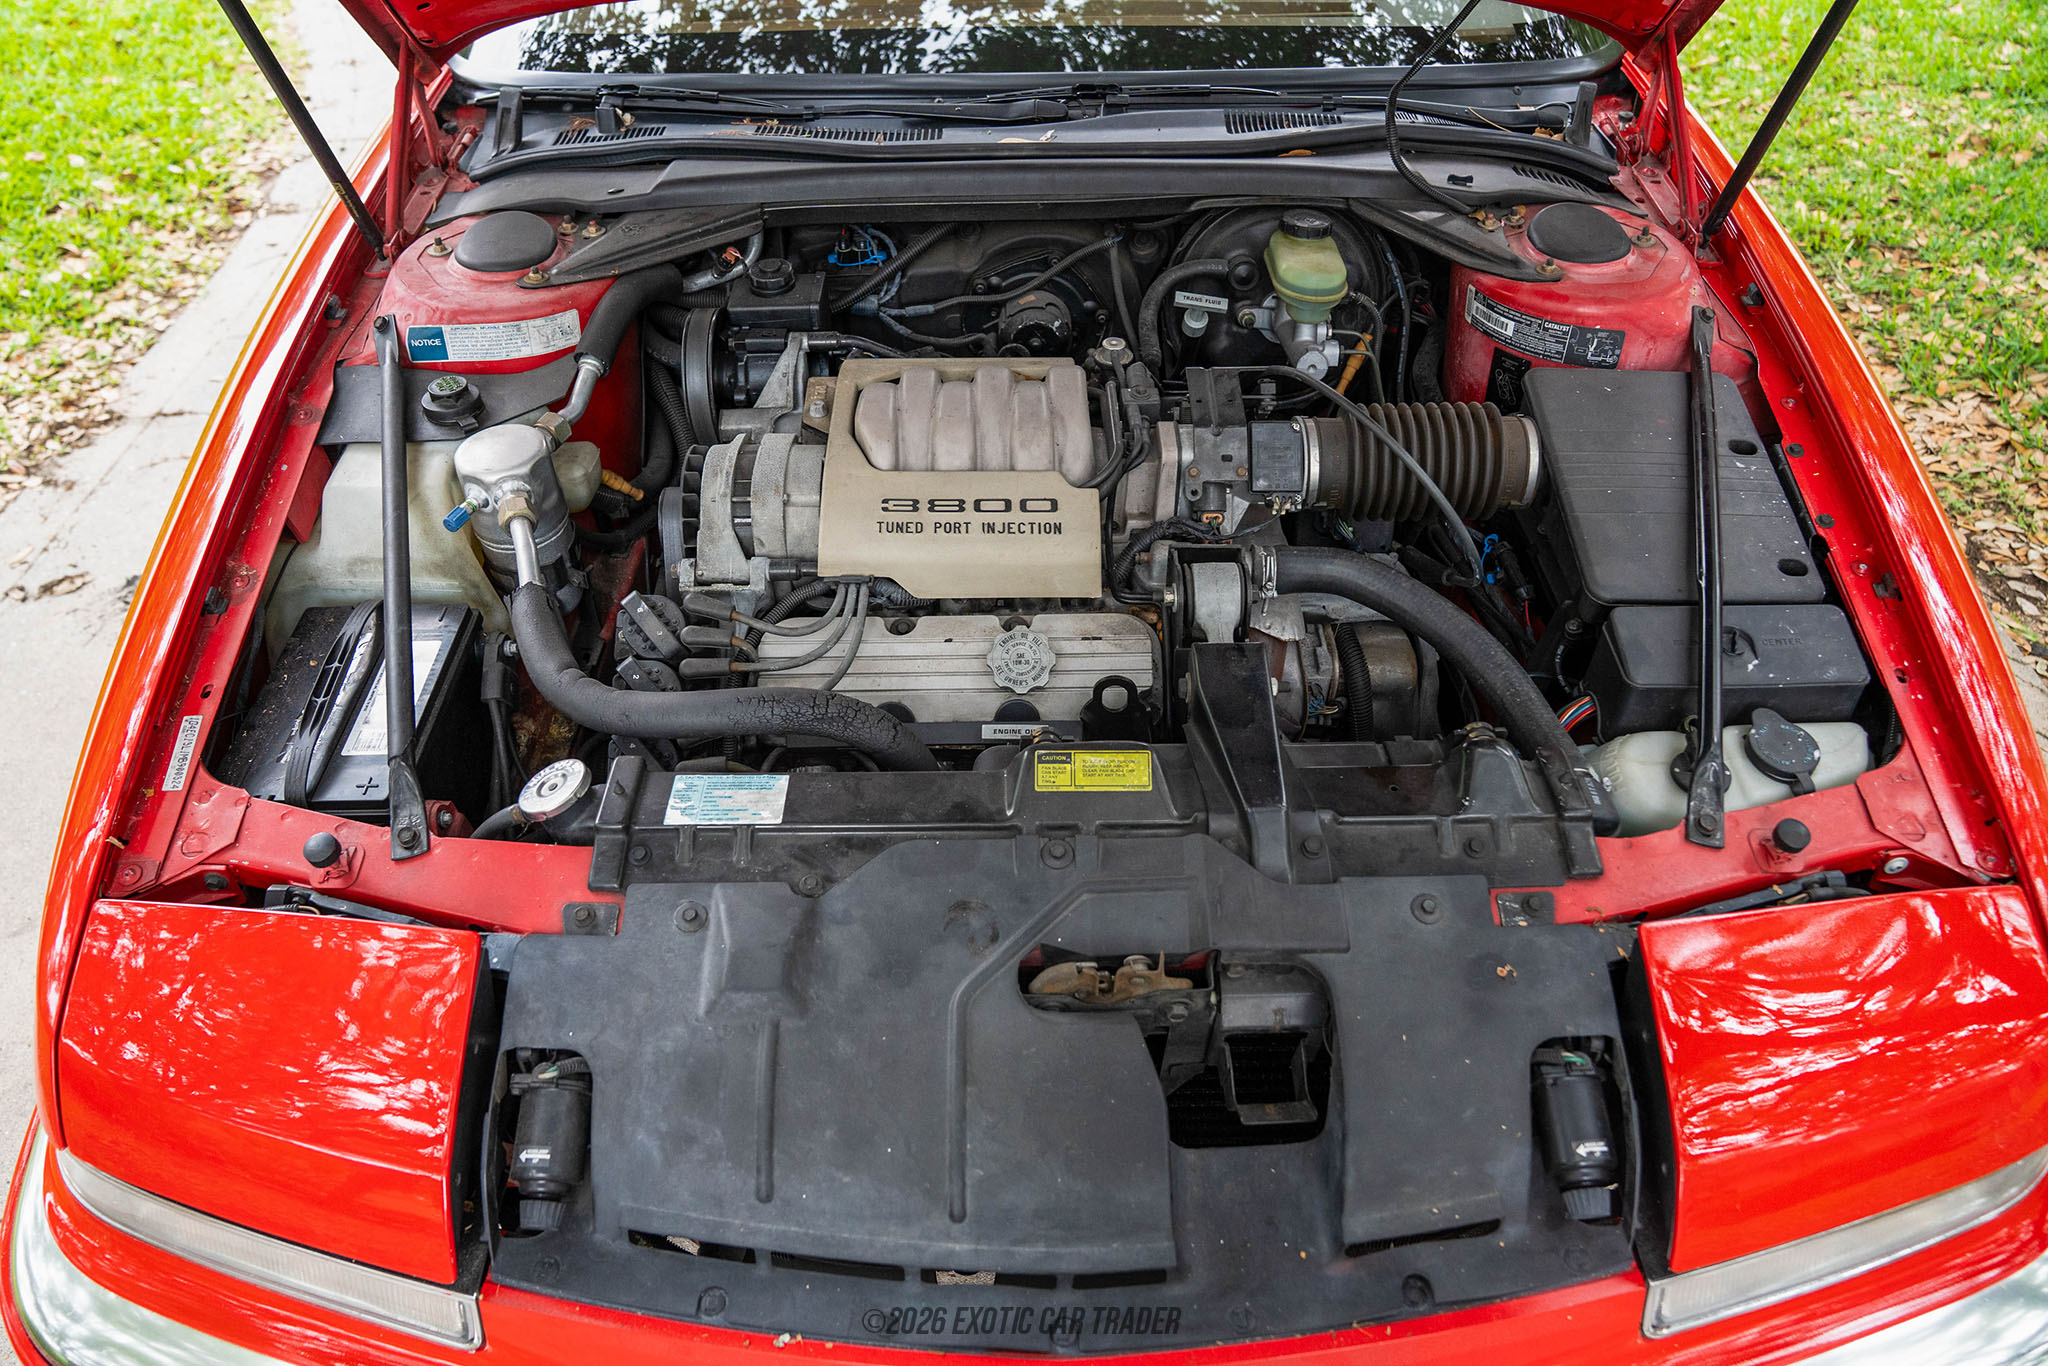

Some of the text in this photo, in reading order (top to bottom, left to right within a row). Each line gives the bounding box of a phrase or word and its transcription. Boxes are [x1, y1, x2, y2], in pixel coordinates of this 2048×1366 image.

[1183, 295, 1222, 306] TRANS FLUID
[1544, 321, 1571, 333] CATALYST
[411, 338, 442, 347] NOTICE
[881, 498, 1059, 513] 3800
[876, 521, 1062, 535] TUNED PORT INJECTION
[998, 632, 1043, 648] ENGINE OIL FILL
[1010, 641, 1027, 649] SERVICE
[1761, 637, 1803, 646] CENTER
[995, 664, 1048, 686] SEE OWNER'S MANUAL
